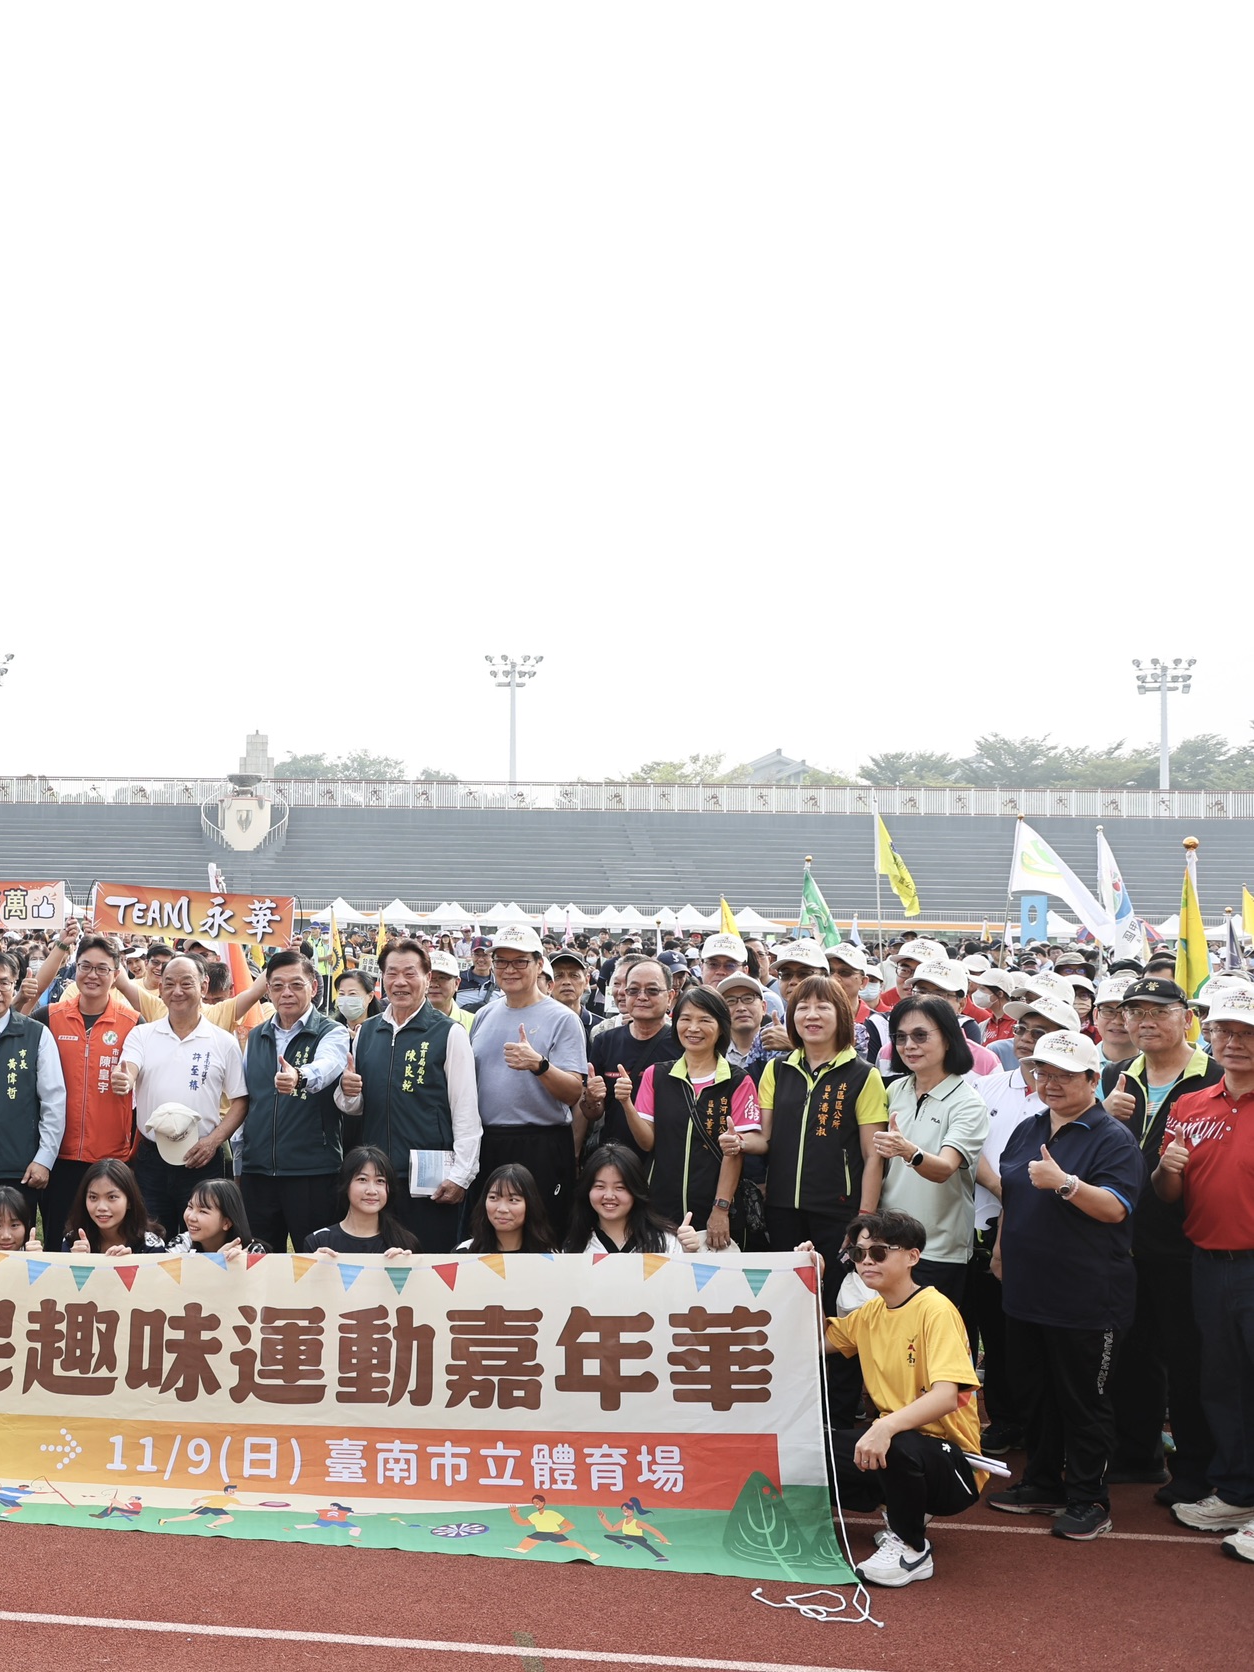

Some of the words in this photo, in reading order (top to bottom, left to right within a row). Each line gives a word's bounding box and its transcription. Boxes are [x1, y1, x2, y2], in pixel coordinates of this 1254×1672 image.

[104, 895, 192, 934] TEAM
[199, 897, 282, 943] 永華
[1133, 981, 1160, 993] 下營
[18, 1048, 29, 1070] 市長
[97, 1055, 111, 1094] 陳皇宇
[401, 1048, 417, 1092] 陳良乾
[416, 1041, 430, 1085] 體育局局長
[6, 1058, 18, 1100] 黃偉哲
[822, 1084, 832, 1100] 區長
[706, 1099, 715, 1116] 區長
[717, 1096, 729, 1134] 白河區公
[815, 1102, 830, 1137] 潘寶淑
[831, 1082, 848, 1130] 北區區公所
[1100, 1331, 1114, 1370] TAINAN
[105, 1434, 302, 1485] 11/9(日)
[324, 1437, 685, 1493] 臺南市立體育場
